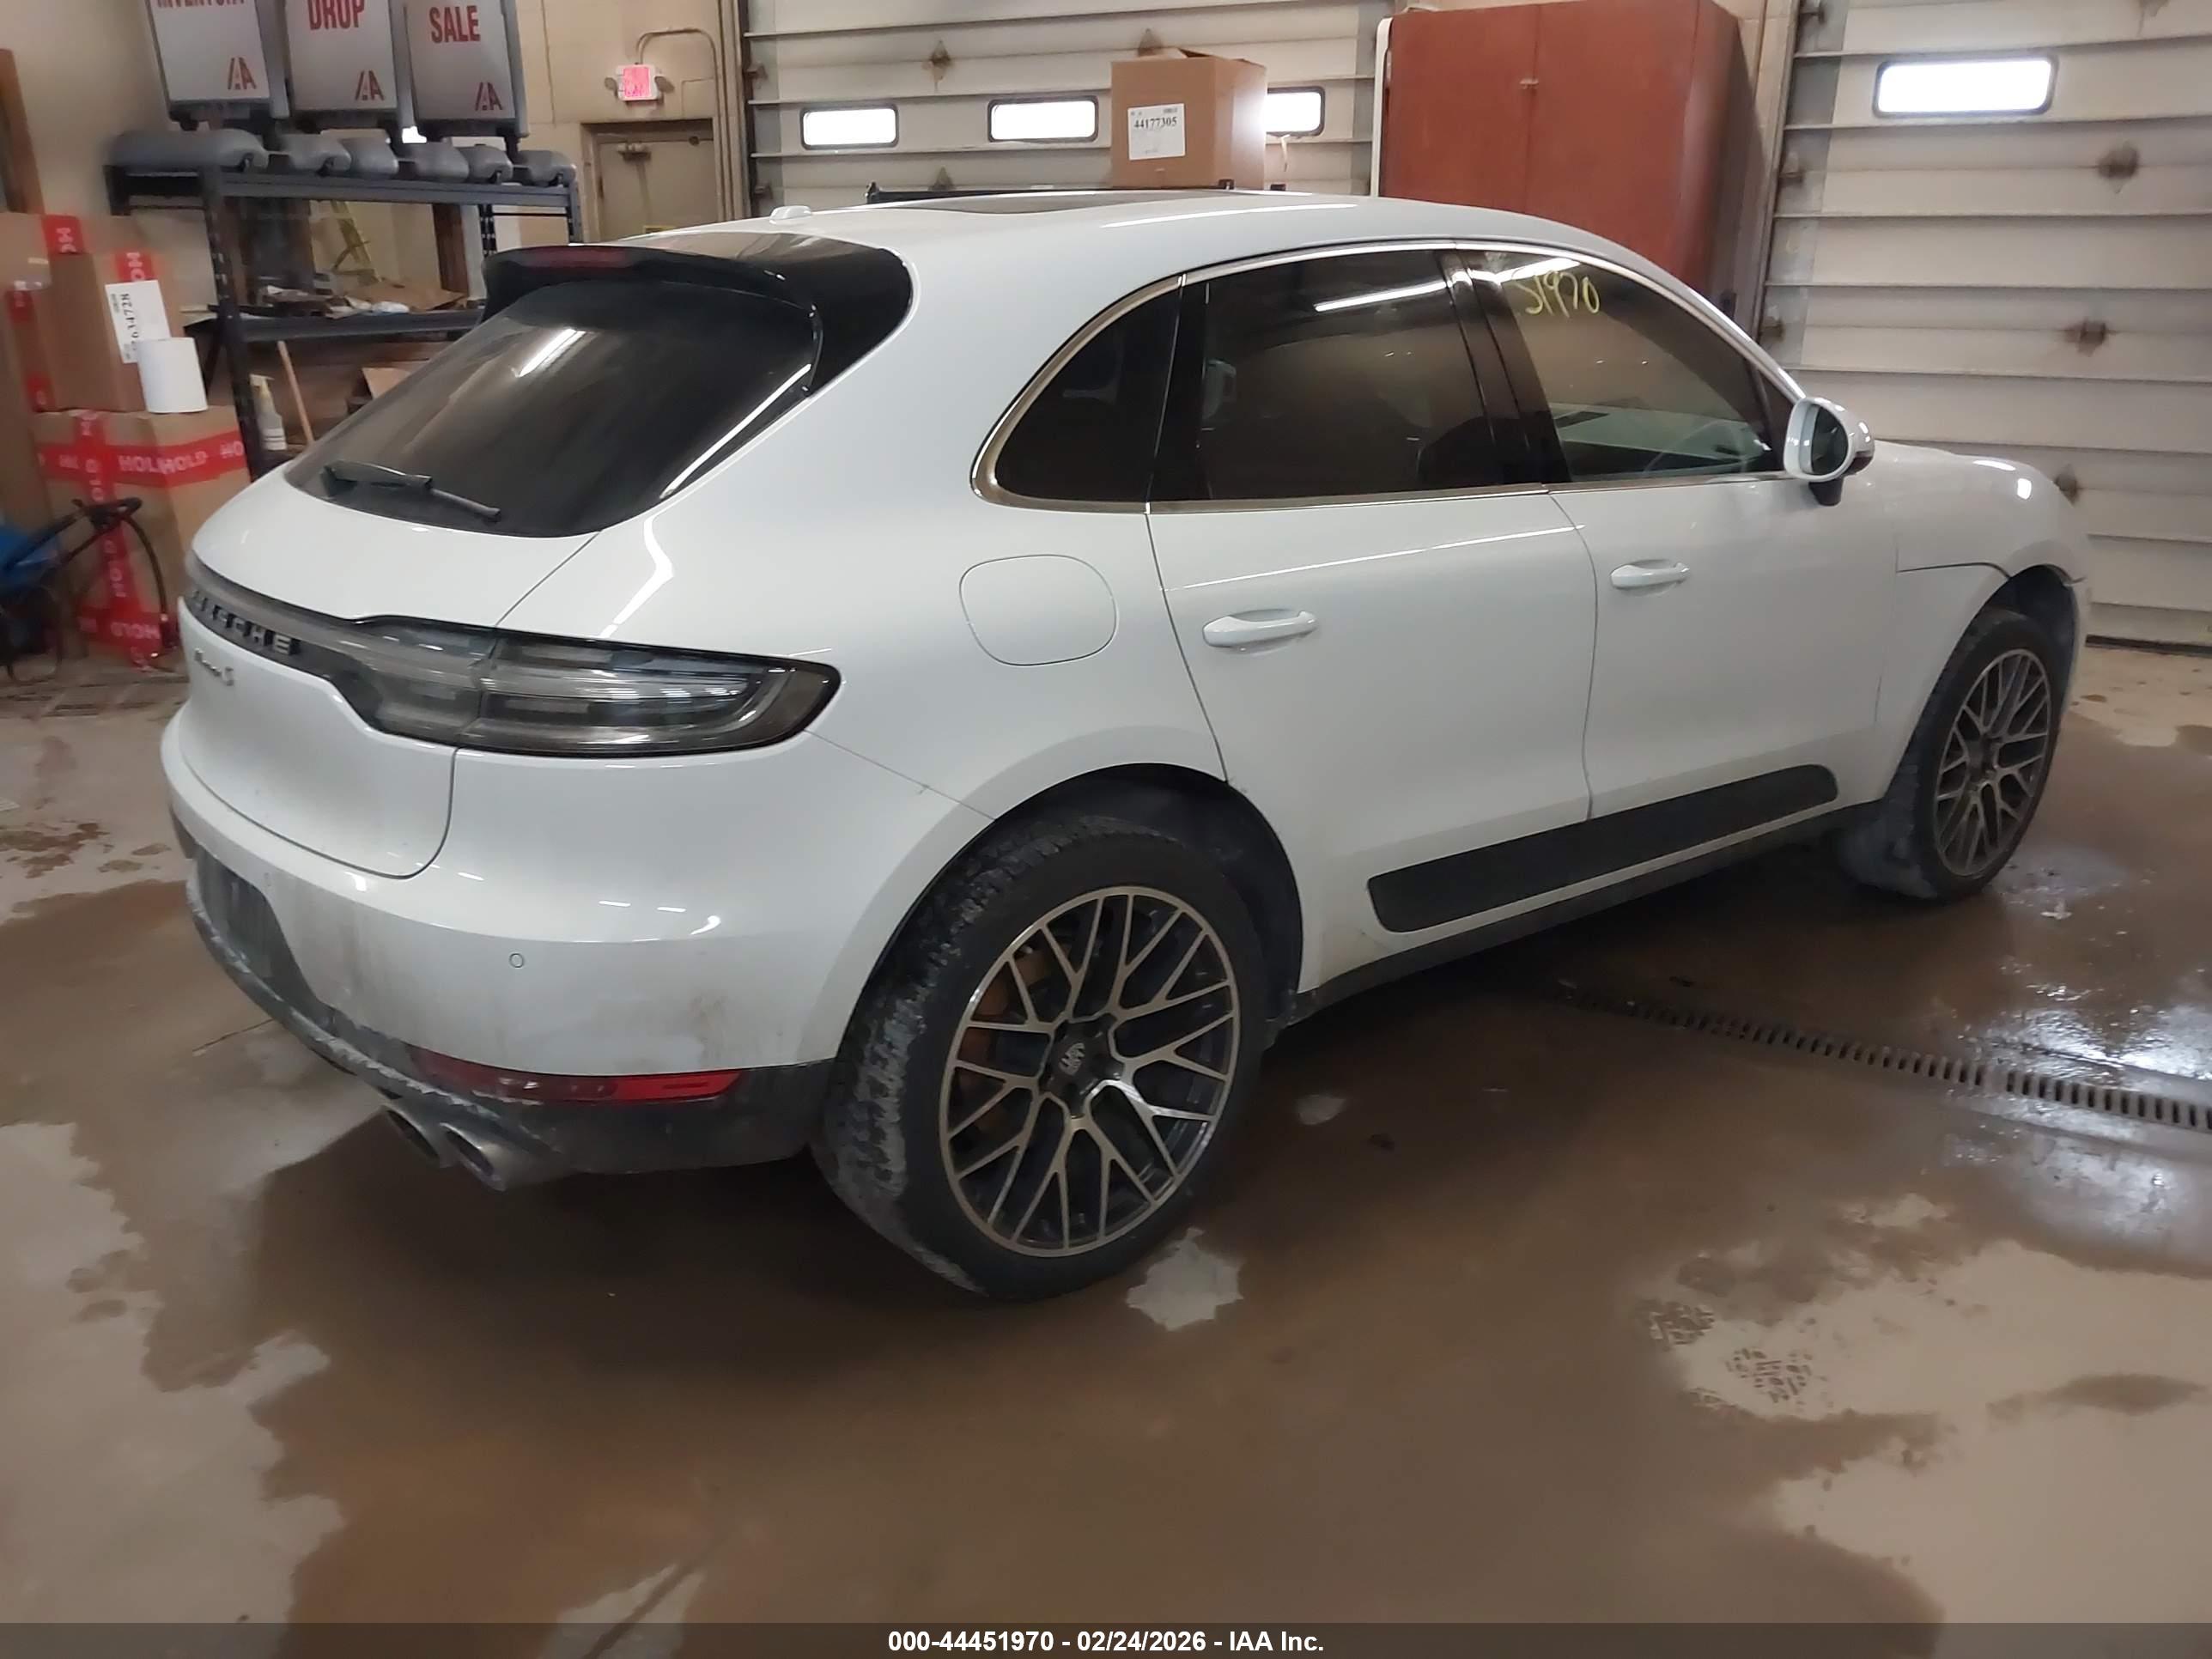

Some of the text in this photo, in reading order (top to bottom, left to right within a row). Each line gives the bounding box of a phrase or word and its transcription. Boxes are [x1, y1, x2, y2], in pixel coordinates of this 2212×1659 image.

[307, 0, 365, 30] DROP
[429, 5, 481, 44] SALE
[191, 589, 292, 656] SCHE
